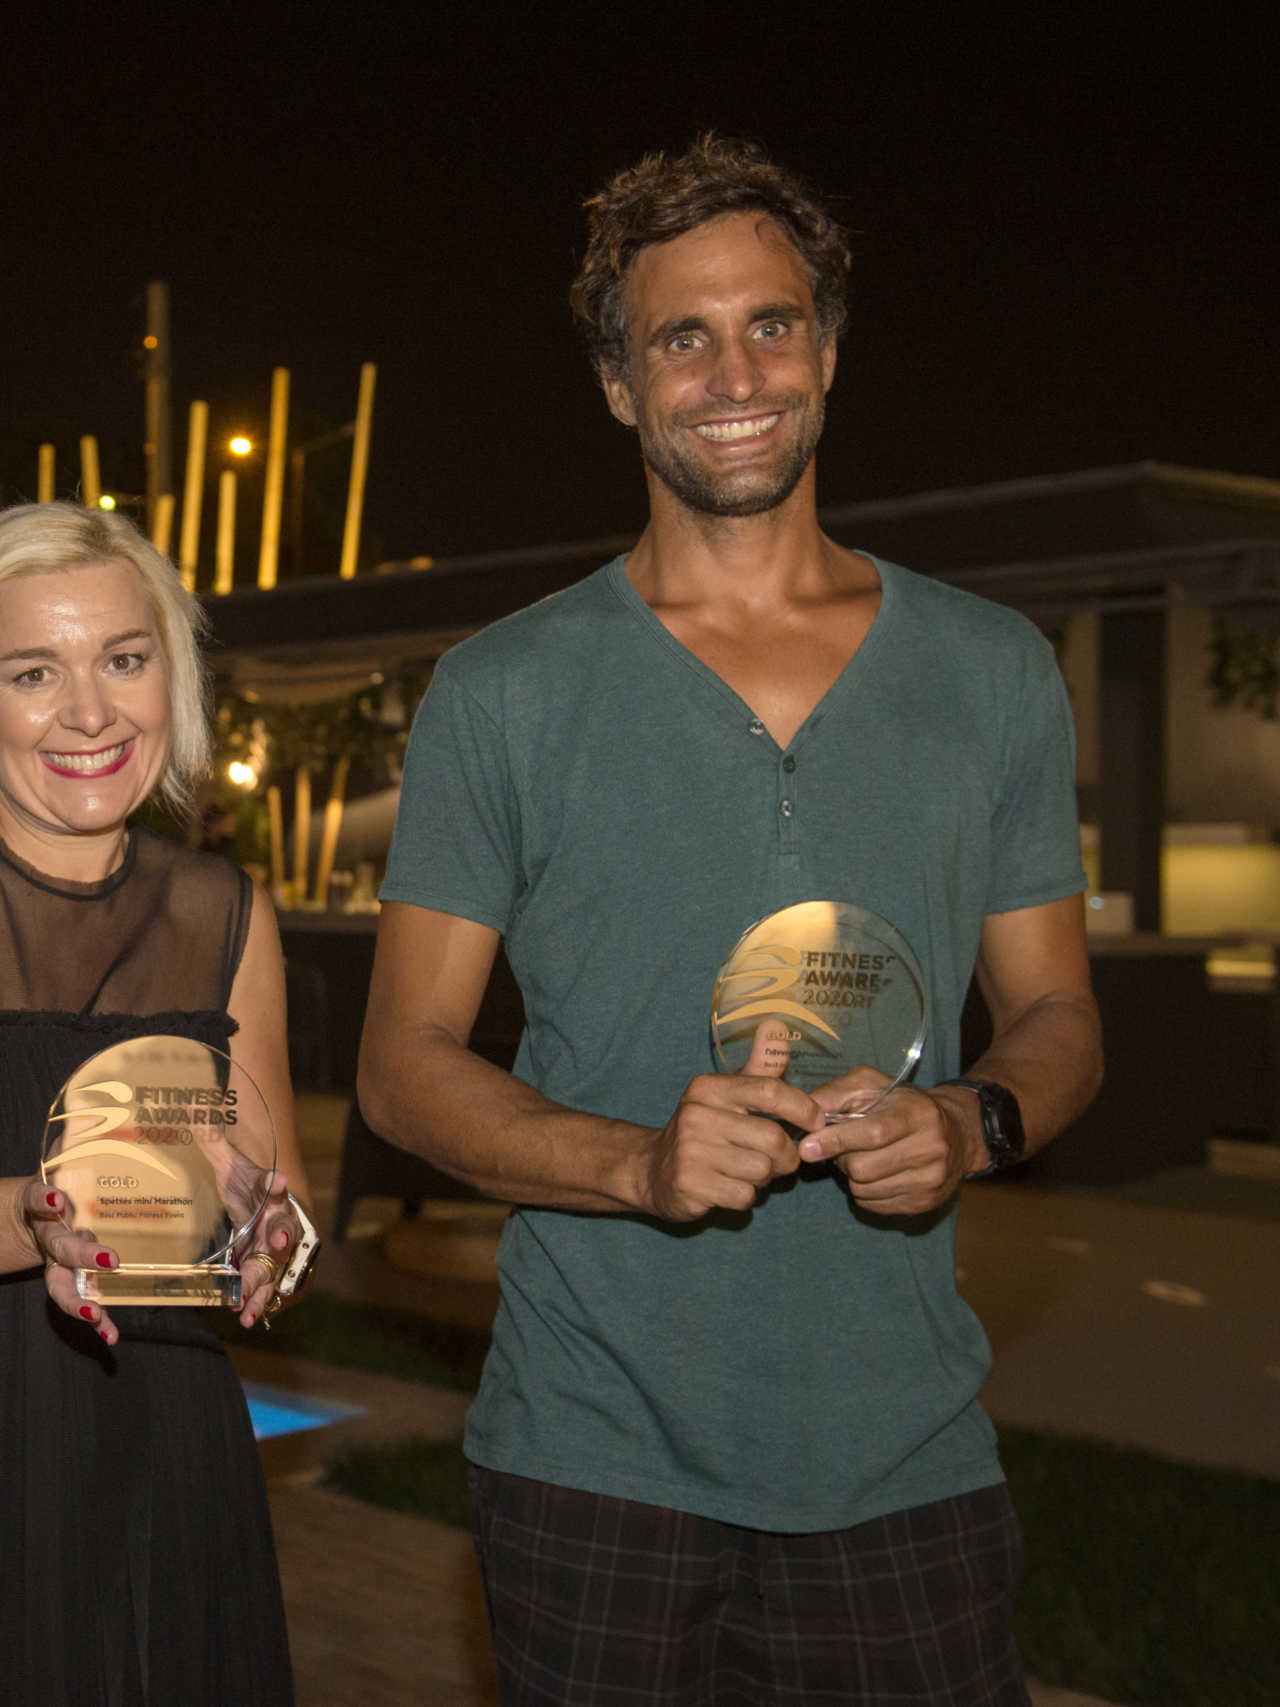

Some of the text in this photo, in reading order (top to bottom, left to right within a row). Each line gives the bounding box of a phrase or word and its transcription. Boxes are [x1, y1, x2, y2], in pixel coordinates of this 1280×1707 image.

[802, 990, 856, 1006] 2020
[767, 1031, 802, 1041] GOLD
[135, 1087, 238, 1106] FITNESS
[135, 1106, 238, 1125] AWARDS
[98, 1176, 138, 1188] GOLD
[154, 1197, 193, 1206] Marathon
